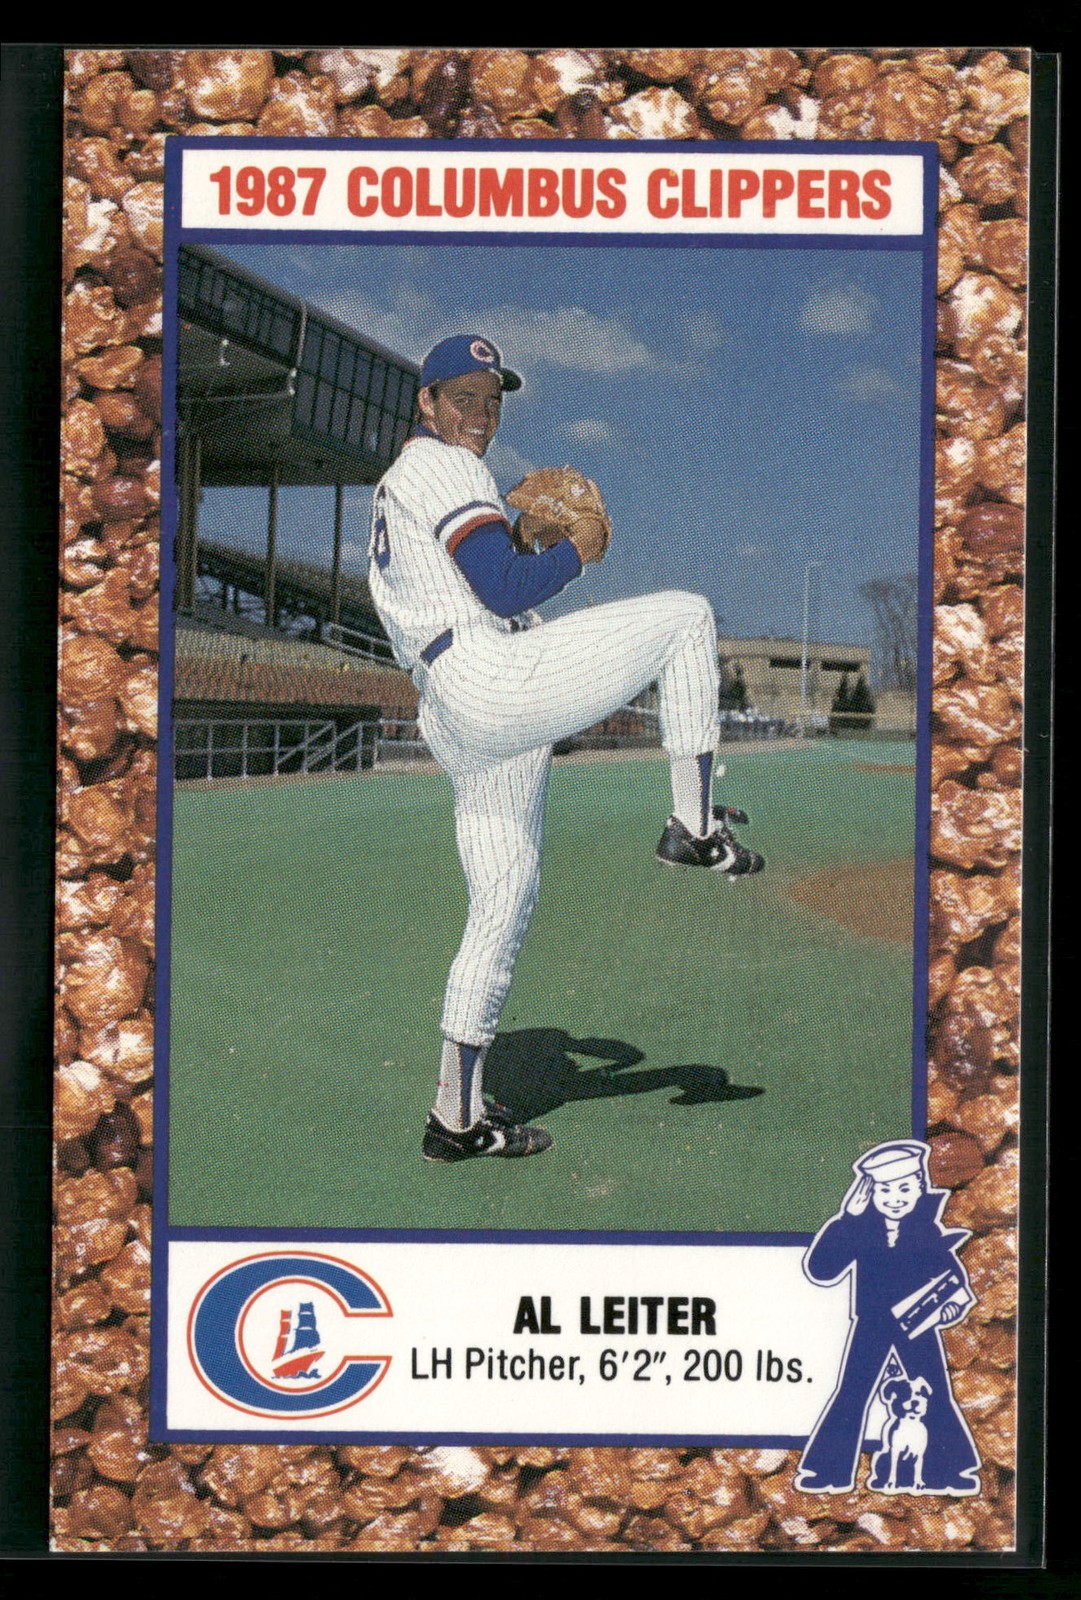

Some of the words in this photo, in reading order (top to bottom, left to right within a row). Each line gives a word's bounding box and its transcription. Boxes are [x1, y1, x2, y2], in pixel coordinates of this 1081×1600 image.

[209, 165, 327, 217] 1987
[347, 166, 627, 219] COLUMBUS
[647, 168, 892, 220] CLIPPERS
[470, 340, 496, 363] C
[186, 1250, 394, 1420] C
[512, 1295, 562, 1335] AL
[580, 1295, 717, 1336] LEITER
[411, 1347, 452, 1380] LH
[465, 1347, 585, 1386] Pitcher,
[683, 1349, 743, 1382] 200
[756, 1349, 813, 1384] lbs.
